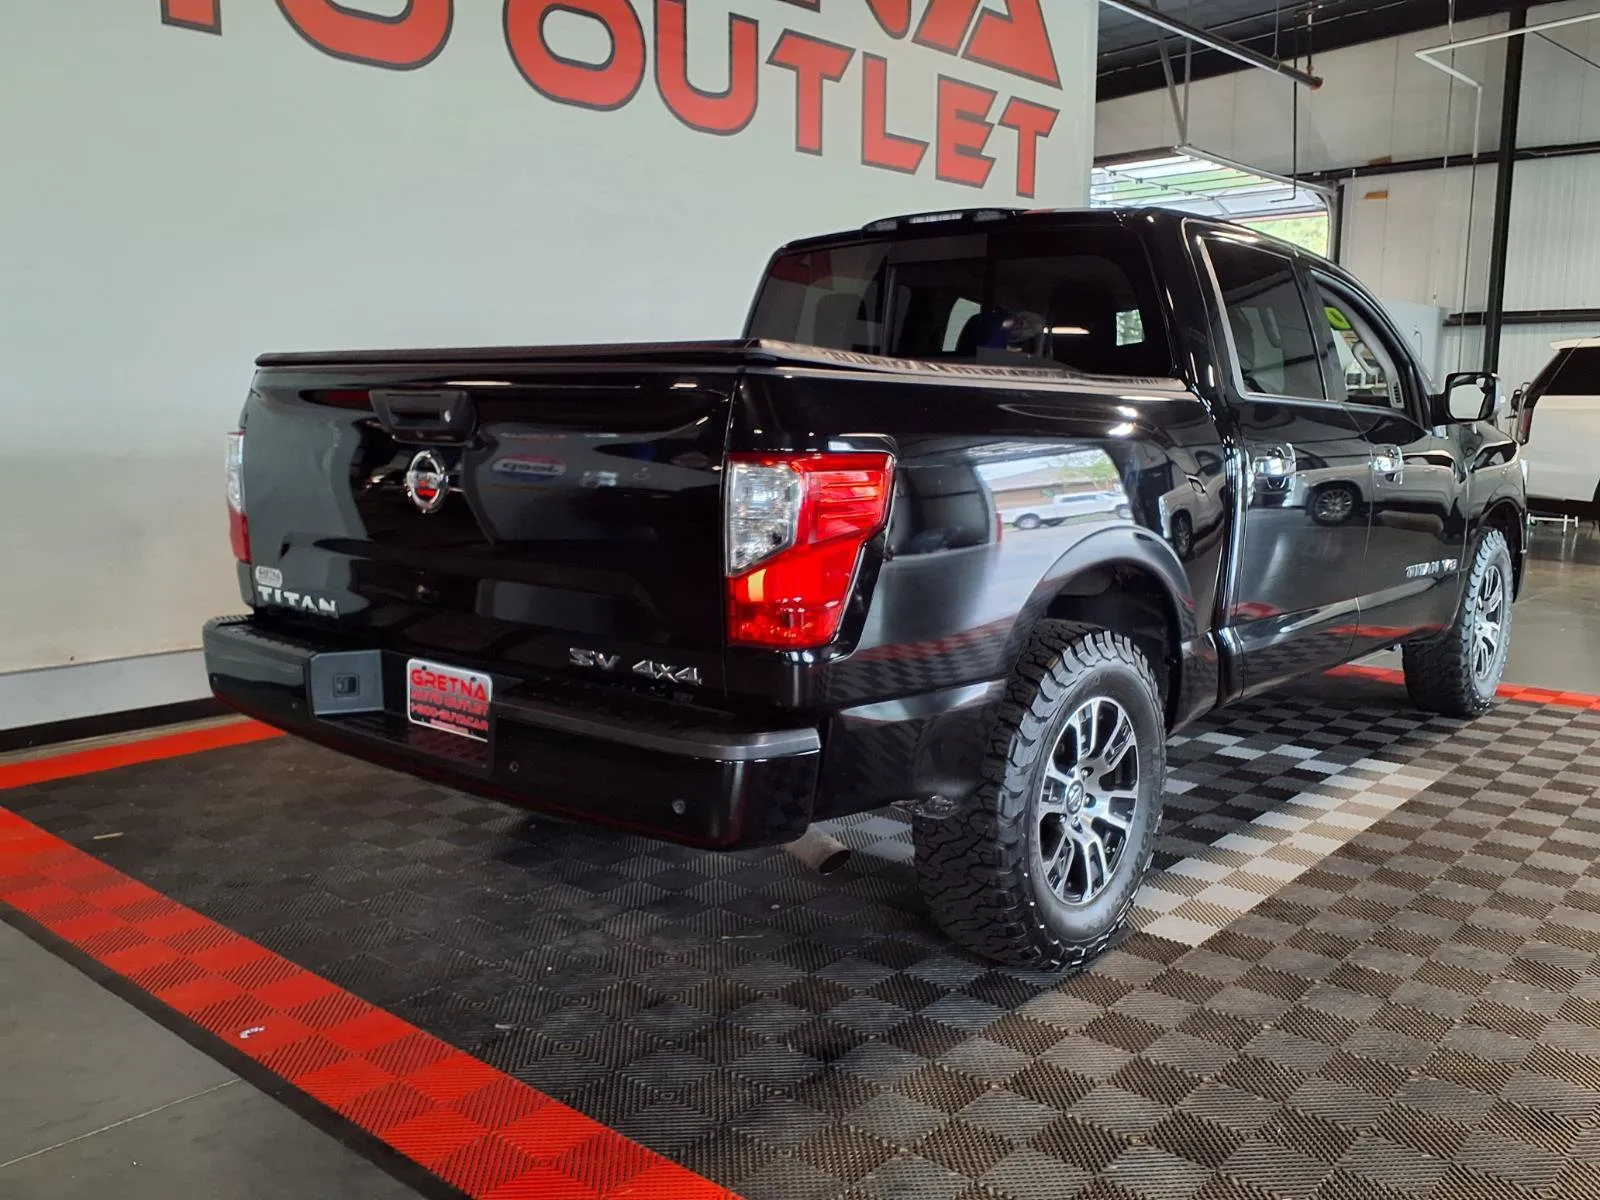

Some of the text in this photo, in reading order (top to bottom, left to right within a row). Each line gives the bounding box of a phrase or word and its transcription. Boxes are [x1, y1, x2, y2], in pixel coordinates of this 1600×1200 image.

[502, 0, 1061, 199] OUTLET
[1405, 561, 1440, 579] TITAN
[257, 585, 338, 615] TITAN
[569, 648, 620, 669] SV
[410, 669, 487, 701] GRETNA
